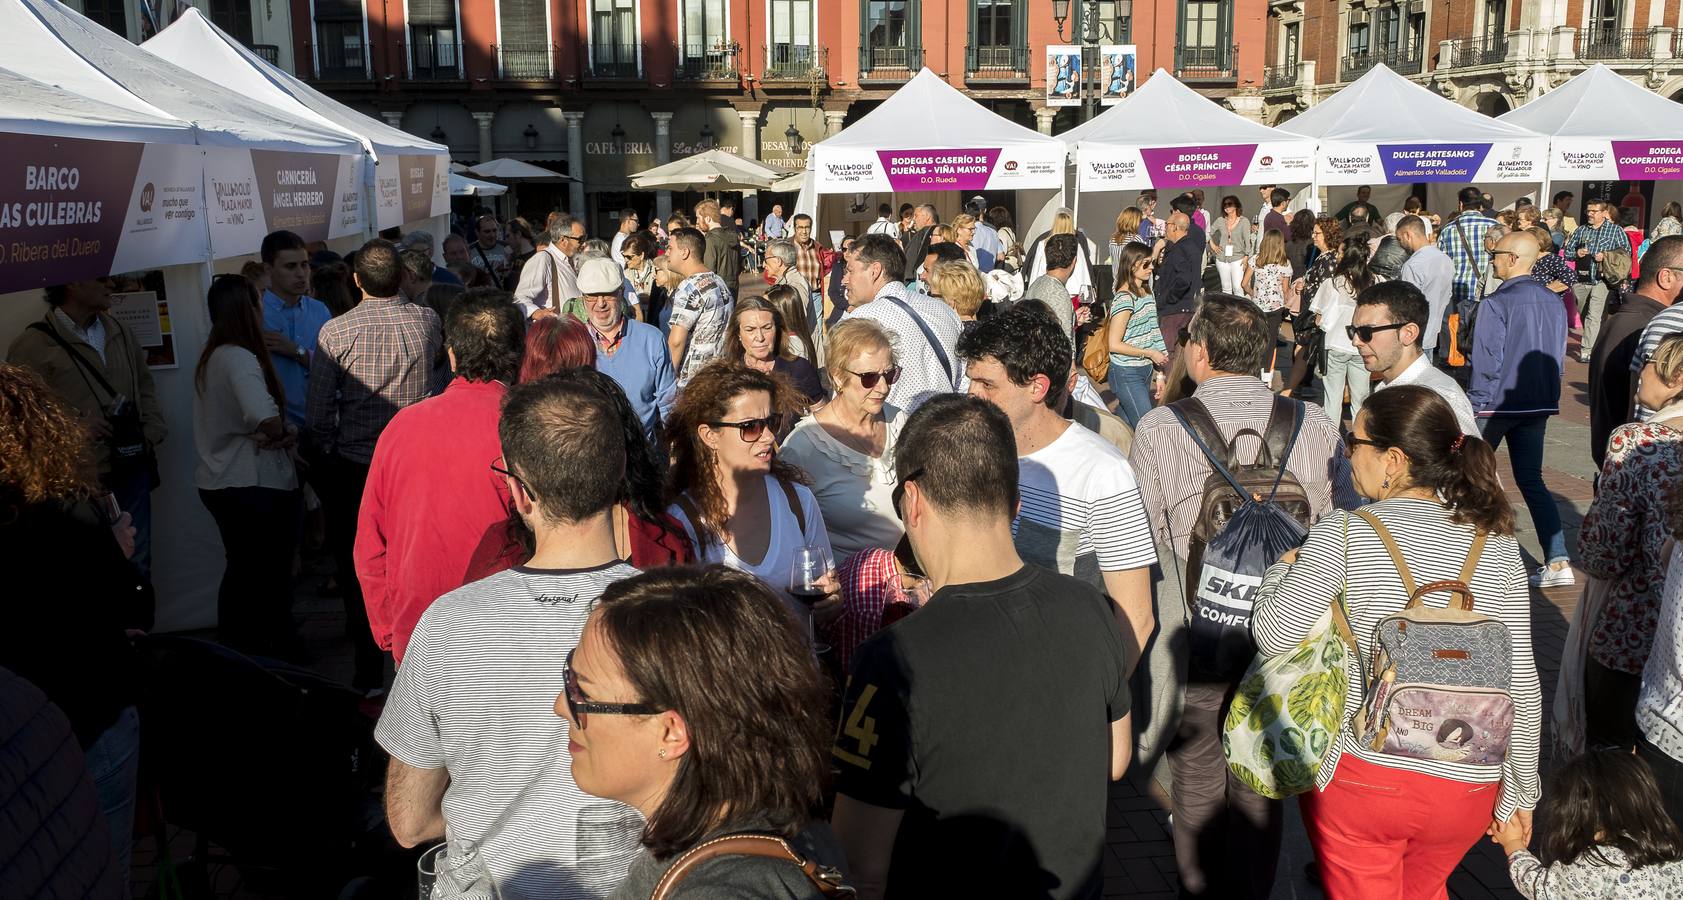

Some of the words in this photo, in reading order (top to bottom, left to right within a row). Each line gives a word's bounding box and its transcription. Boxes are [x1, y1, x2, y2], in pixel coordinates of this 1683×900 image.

[762, 141, 812, 151] DESAYOS
[1178, 154, 1218, 162] BODEGAS
[1426, 150, 1475, 158] ARTESANOS
[763, 158, 808, 168] MERIENDA
[892, 157, 934, 165] BODEGAS
[935, 155, 974, 164] CASERÍO
[975, 156, 987, 164] DE
[890, 166, 926, 174] DUEÑAS
[934, 165, 956, 174] VIÑA
[1164, 164, 1192, 172] CÉSAR
[1193, 162, 1232, 170] PRÍNCIPE
[26, 166, 80, 190] BARCO
[276, 168, 316, 184] CARNICERÍA
[273, 189, 294, 208] ÁNGEL
[294, 192, 324, 208] HERRERO
[0, 203, 22, 228] AS
[26, 201, 102, 226] CULEBRAS
[12, 242, 48, 263] Ribera
[52, 238, 68, 259] del
[72, 238, 101, 256] Duero
[1398, 706, 1432, 718] DREAM
[1412, 720, 1434, 731] BIG
[1396, 728, 1408, 736] AND
